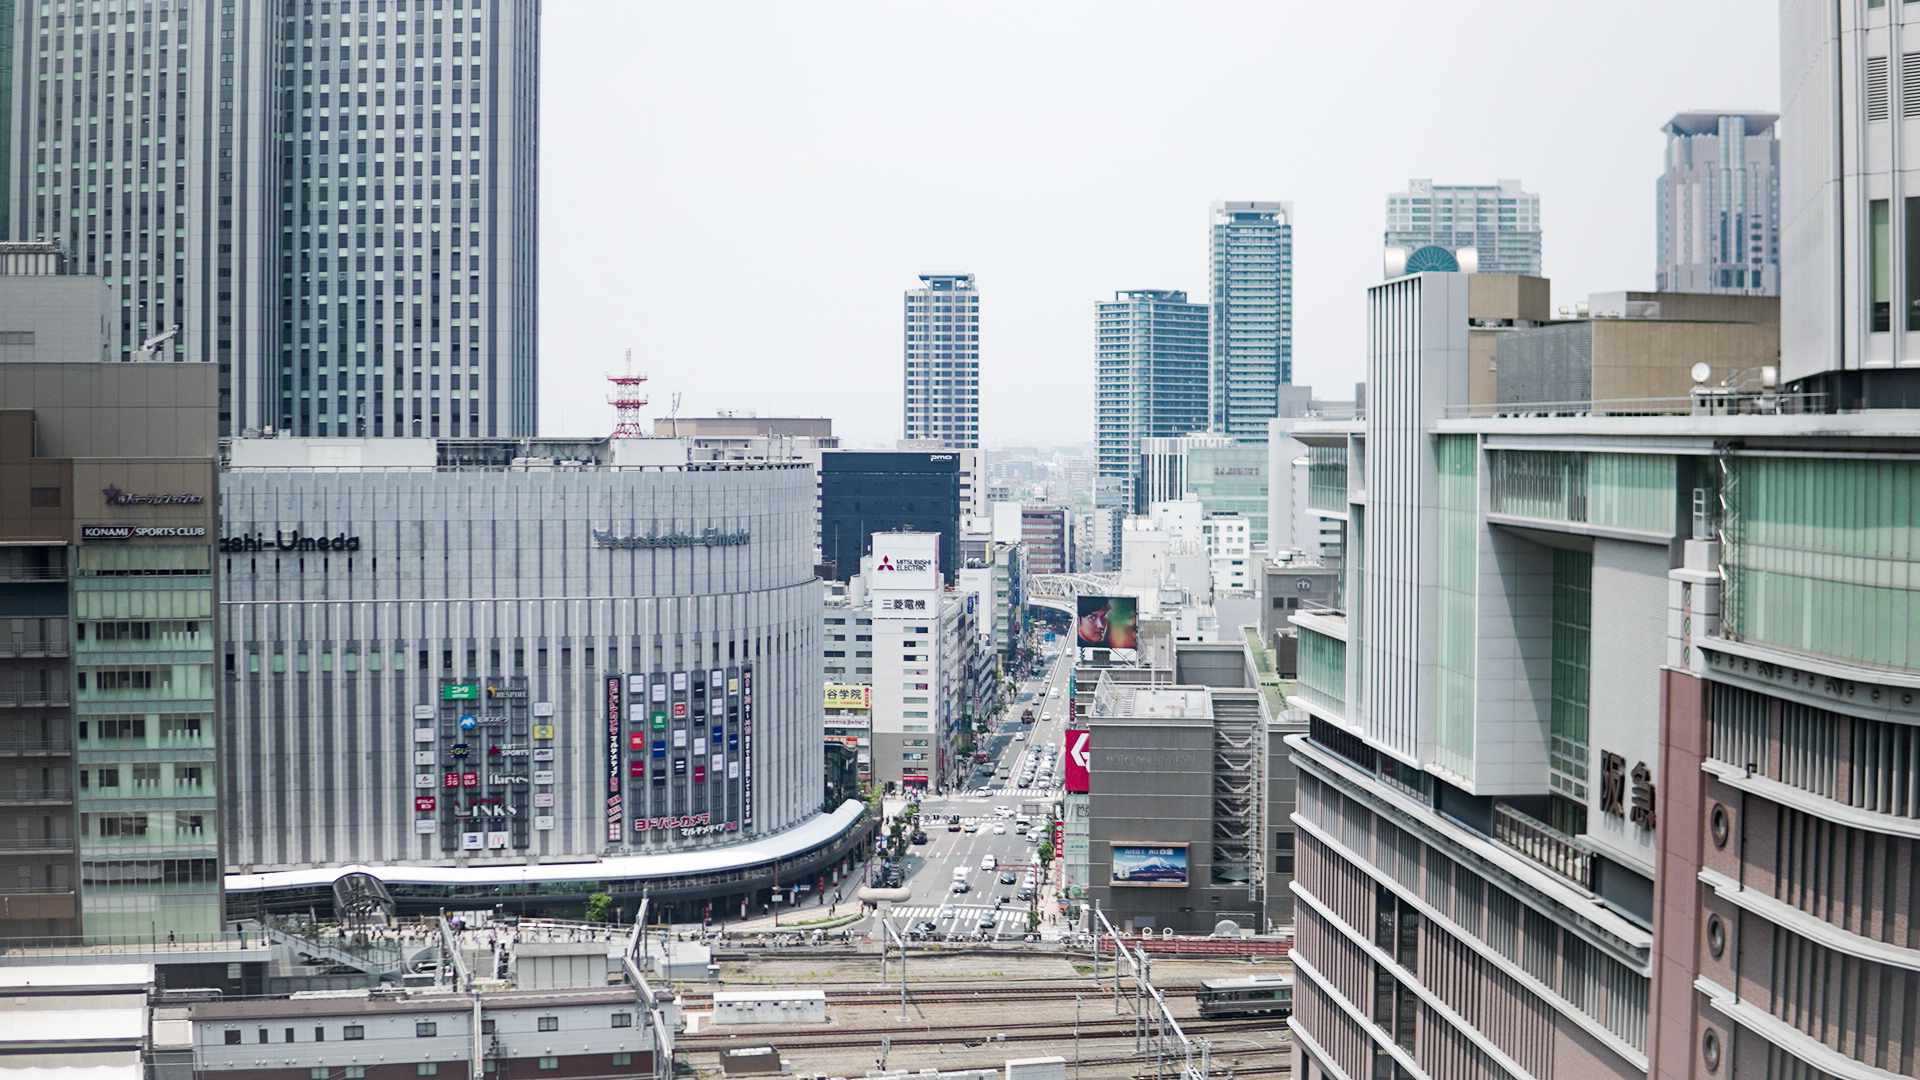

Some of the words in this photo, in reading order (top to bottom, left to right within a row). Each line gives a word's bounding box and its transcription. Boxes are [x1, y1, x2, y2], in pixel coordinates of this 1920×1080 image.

[85, 527, 129, 537] KONAMI
[134, 527, 175, 536] SPORTS
[176, 527, 205, 536] CLUB
[882, 599, 926, 610] 三菱電機
[496, 691, 527, 699] RESPIRE
[823, 689, 862, 700] 谷学院
[454, 747, 467, 755] GU
[1600, 749, 1656, 832] 阪急
[454, 802, 517, 817] LINKS
[634, 814, 710, 832] ヨドバシカメラ
